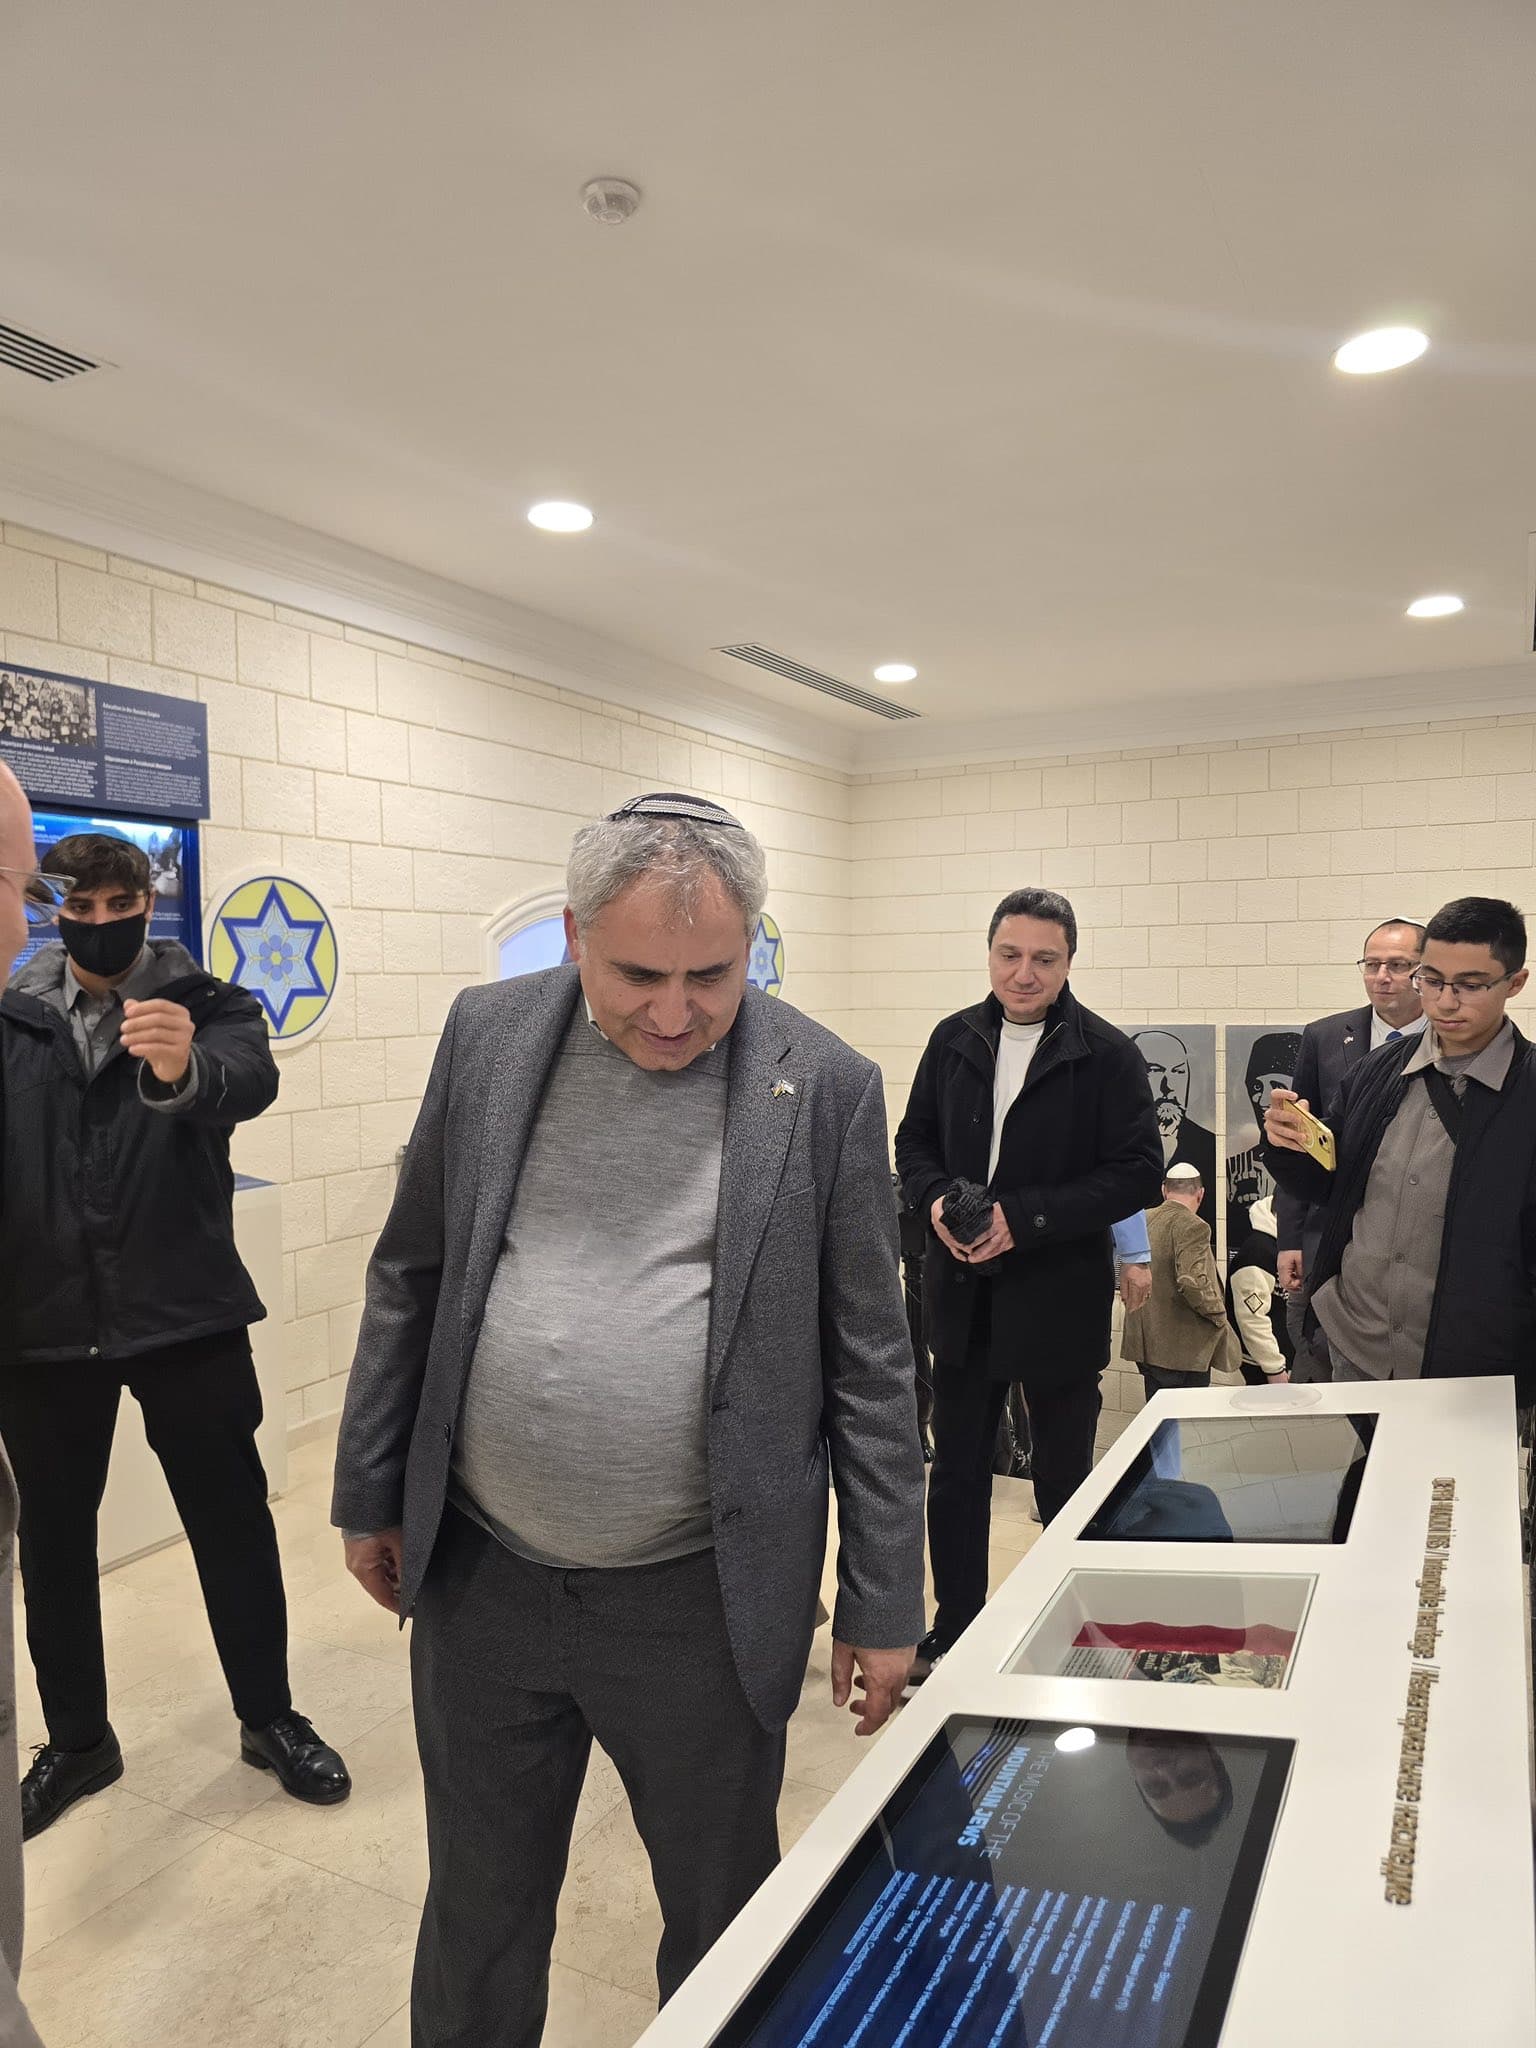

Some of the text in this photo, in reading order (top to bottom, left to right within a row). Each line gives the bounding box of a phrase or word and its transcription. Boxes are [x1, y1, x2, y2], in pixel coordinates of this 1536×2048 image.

[1415, 1558, 1449, 1607] Intangible
[1407, 1608, 1445, 1658] heritage
[957, 1746, 1031, 1846] MOUNTAIN JEWS
[979, 1748, 1057, 1859] THE MUSIC OF THE
